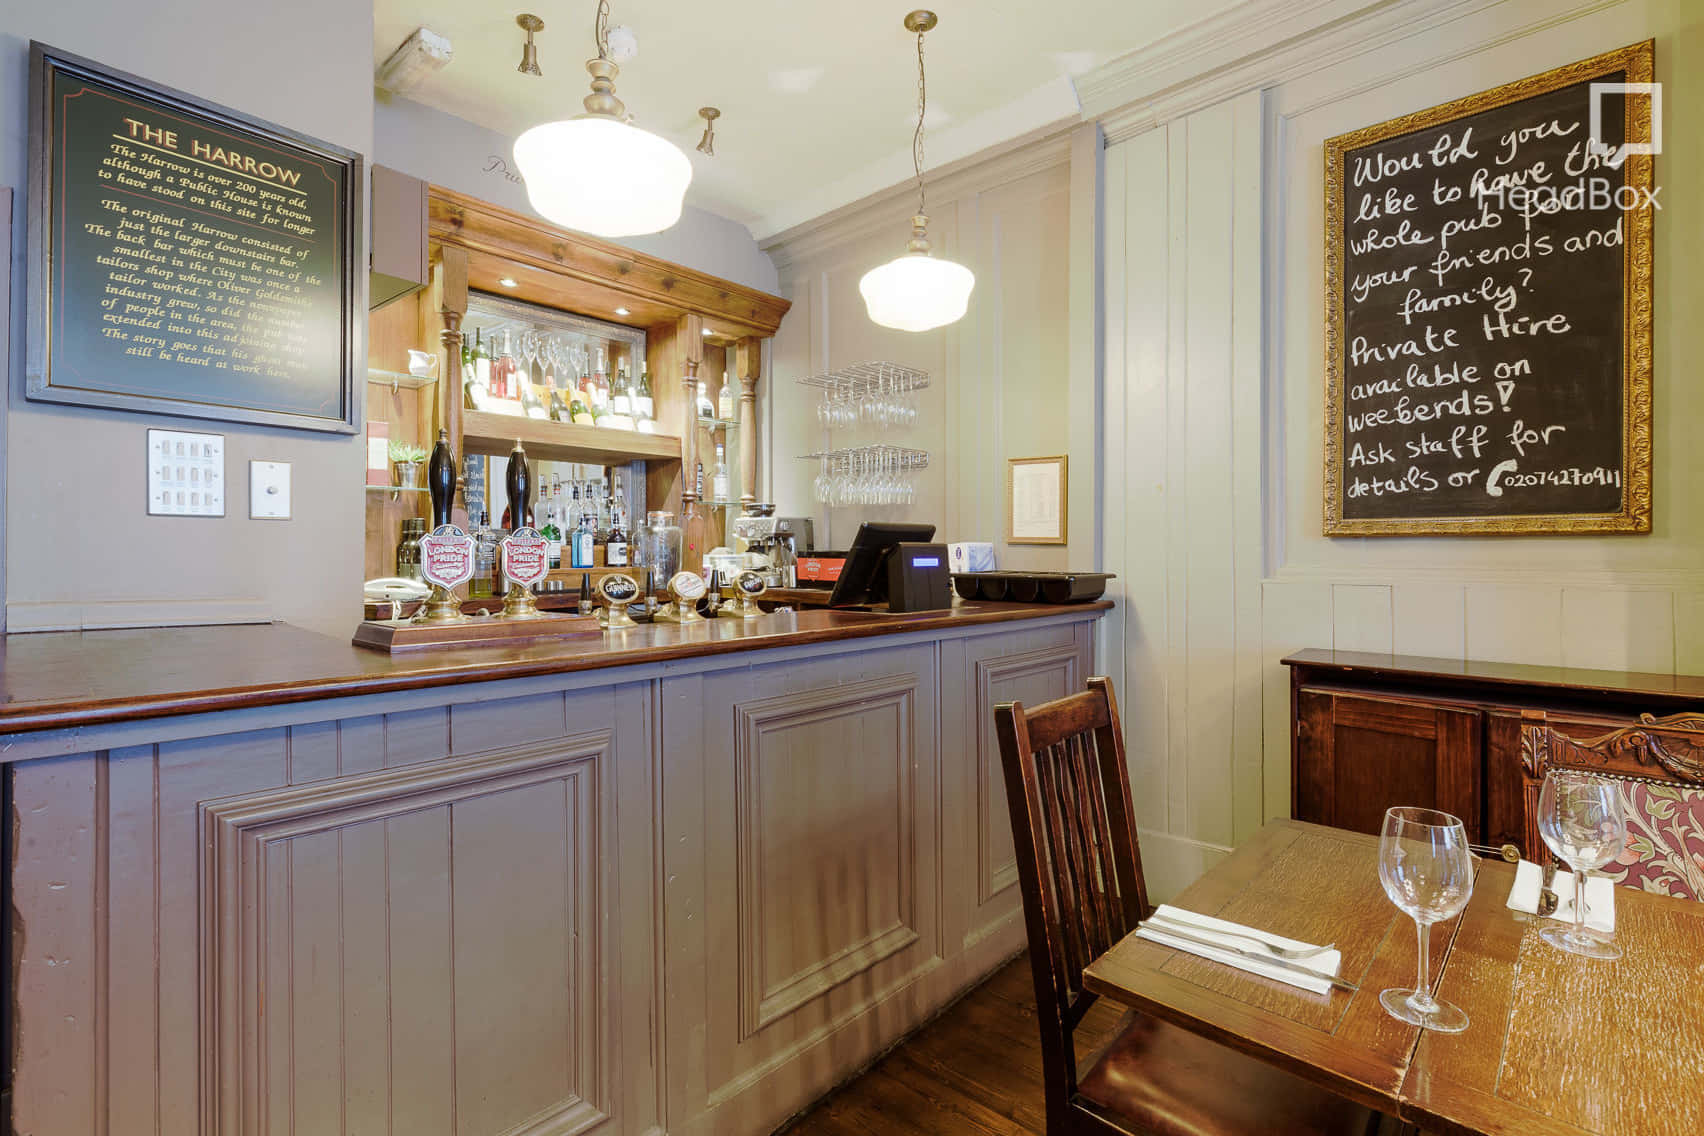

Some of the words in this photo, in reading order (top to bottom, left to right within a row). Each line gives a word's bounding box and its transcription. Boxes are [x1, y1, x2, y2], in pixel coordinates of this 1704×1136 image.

[123, 118, 177, 149] THE
[191, 139, 301, 187] HARROW
[1354, 128, 1478, 186] Would
[1496, 120, 1580, 164] you
[103, 157, 161, 179] although
[166, 175, 174, 183] a
[179, 177, 218, 195] Public
[223, 189, 258, 207] House
[262, 201, 272, 211] is
[276, 205, 312, 222] known
[110, 144, 136, 158] The
[140, 153, 190, 173] Harrow
[194, 169, 204, 178] is
[207, 174, 232, 186] over
[236, 181, 256, 193] 200
[259, 190, 286, 202] years
[288, 197, 307, 209] old,
[1353, 188, 1419, 224] like
[1433, 179, 1461, 205] to
[1471, 162, 1552, 198] have
[1564, 137, 1628, 177] the
[98, 169, 112, 179] to
[117, 173, 147, 189] have
[152, 185, 185, 199] stood
[190, 196, 205, 205] on
[210, 200, 232, 212] this
[236, 207, 257, 219] site
[261, 213, 280, 224] for
[283, 219, 316, 235] longer
[1351, 220, 1434, 257] whole
[1441, 203, 1502, 247] pub
[1518, 188, 1585, 231] for
[101, 199, 128, 213] The
[131, 209, 186, 228] original
[191, 222, 238, 240] Harrow
[241, 236, 293, 255] consisted
[296, 249, 310, 261] of
[116, 217, 145, 231] just
[151, 225, 170, 237] the
[174, 230, 210, 246] larger
[214, 241, 275, 262] downstairs
[280, 256, 299, 268] bar.
[84, 223, 112, 237] The
[116, 230, 147, 246] back
[153, 239, 174, 252] bar
[178, 247, 214, 261] which
[219, 256, 246, 268] must
[251, 261, 262, 272] be
[266, 267, 285, 277] one
[288, 271, 302, 283] of
[306, 275, 321, 287] the
[96, 255, 140, 271] tailors
[144, 265, 174, 280] shop
[178, 273, 214, 287] where
[216, 280, 251, 294] Oliver
[113, 246, 166, 264] smallest
[171, 256, 184, 267] in
[190, 261, 208, 272] the
[212, 266, 236, 280] City
[240, 274, 262, 285] was
[266, 280, 290, 291] once
[1351, 266, 1418, 302] your
[1428, 231, 1554, 286] friends
[1564, 217, 1623, 252] and
[101, 298, 119, 310] of
[125, 303, 166, 317] people
[170, 309, 182, 320] in
[187, 313, 206, 324] the
[105, 283, 161, 305] industry
[205, 305, 217, 313] so
[221, 306, 241, 318] did
[109, 271, 147, 286] tailor
[228, 295, 246, 306] the
[1398, 269, 1534, 325] family?
[102, 327, 128, 340] The
[133, 334, 166, 349] story
[170, 341, 198, 351] goes
[202, 344, 227, 355] that
[103, 314, 162, 329] extended
[168, 322, 192, 335] into
[196, 328, 219, 339] this
[1351, 326, 1460, 367] Private
[1484, 312, 1572, 341] Hire
[124, 346, 155, 357] still
[160, 349, 172, 360] be
[176, 352, 211, 366] heard
[1351, 362, 1480, 400] available
[1494, 358, 1532, 379] on
[1348, 443, 1396, 468] Ask
[1406, 425, 1489, 458] staff
[1505, 420, 1566, 456] for
[1348, 466, 1439, 499] details
[1448, 468, 1480, 487] or
[1505, 467, 1621, 488] 02074270911
[428, 545, 467, 555] LONDON
[432, 554, 464, 562] PRIDE
[508, 545, 545, 556] LONDON
[512, 554, 540, 562] PRIDE
